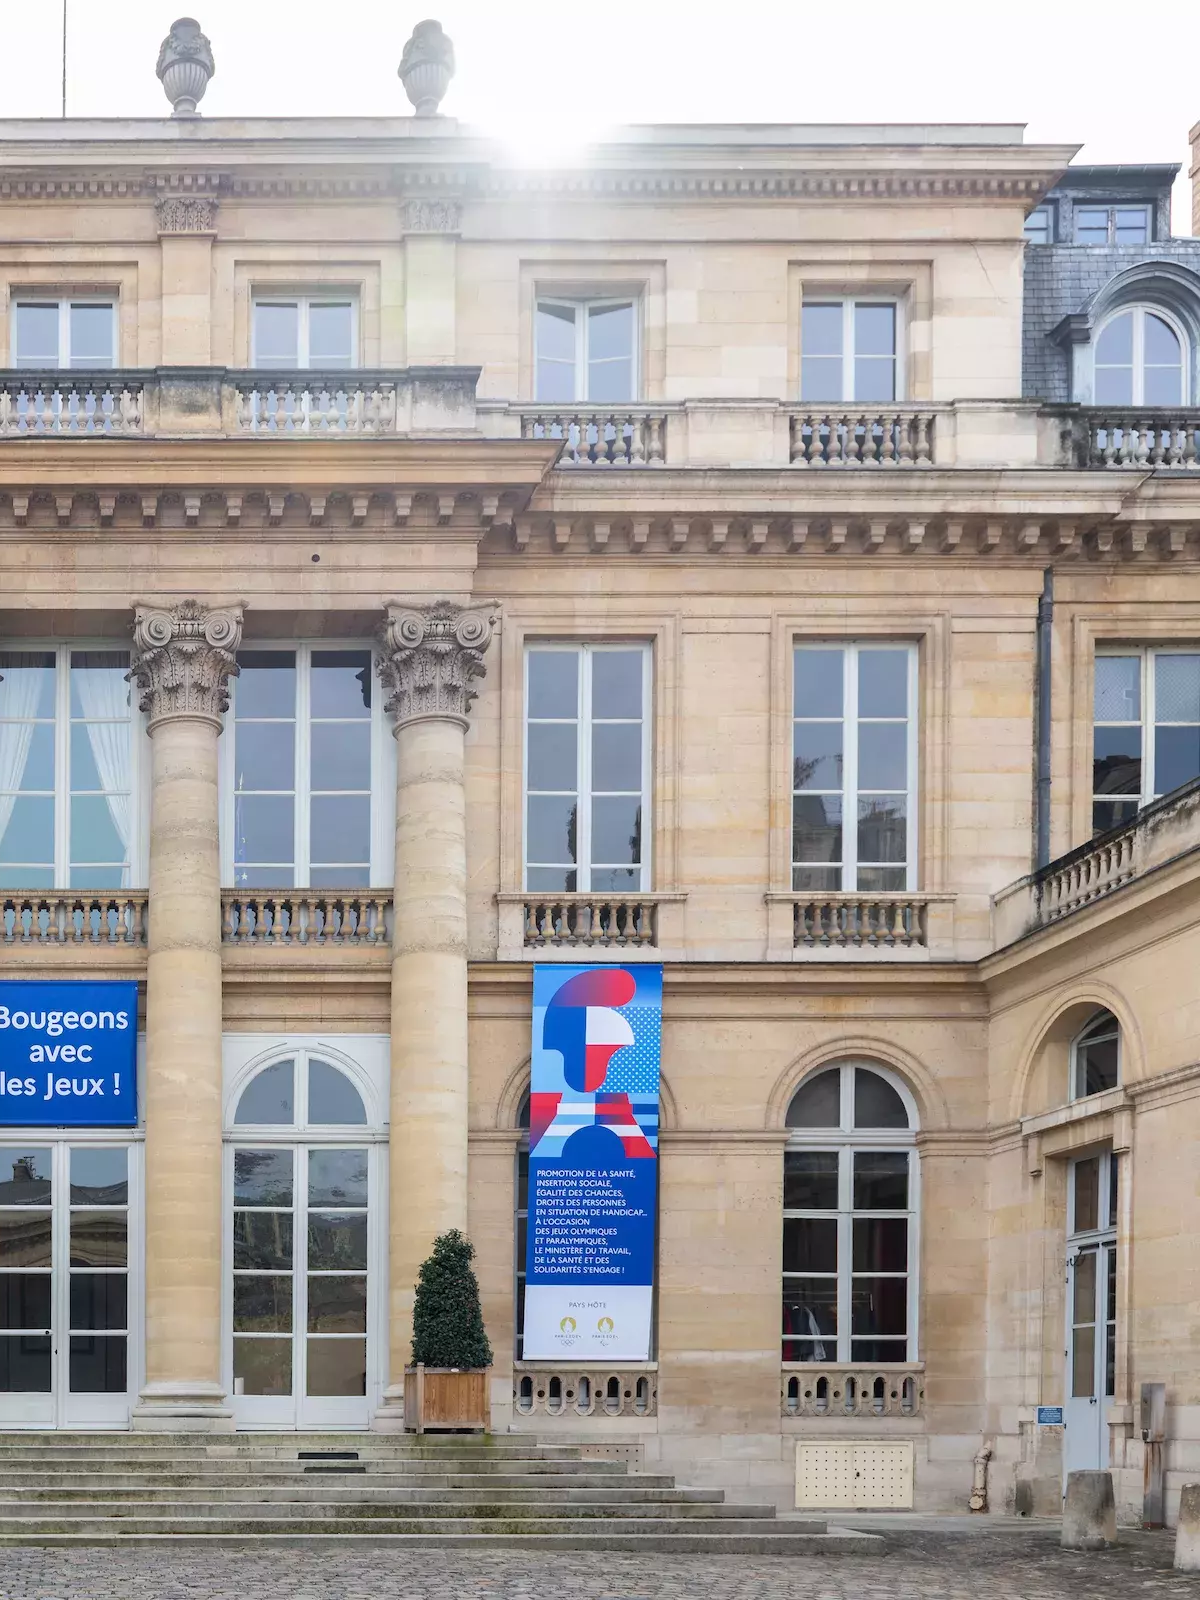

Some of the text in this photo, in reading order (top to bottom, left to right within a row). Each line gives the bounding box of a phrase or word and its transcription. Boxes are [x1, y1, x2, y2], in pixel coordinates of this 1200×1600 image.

[29, 1044, 93, 1063] avec
[0, 1071, 120, 1100] les Jeux !
[610, 1169, 636, 1178] SANTÉ,
